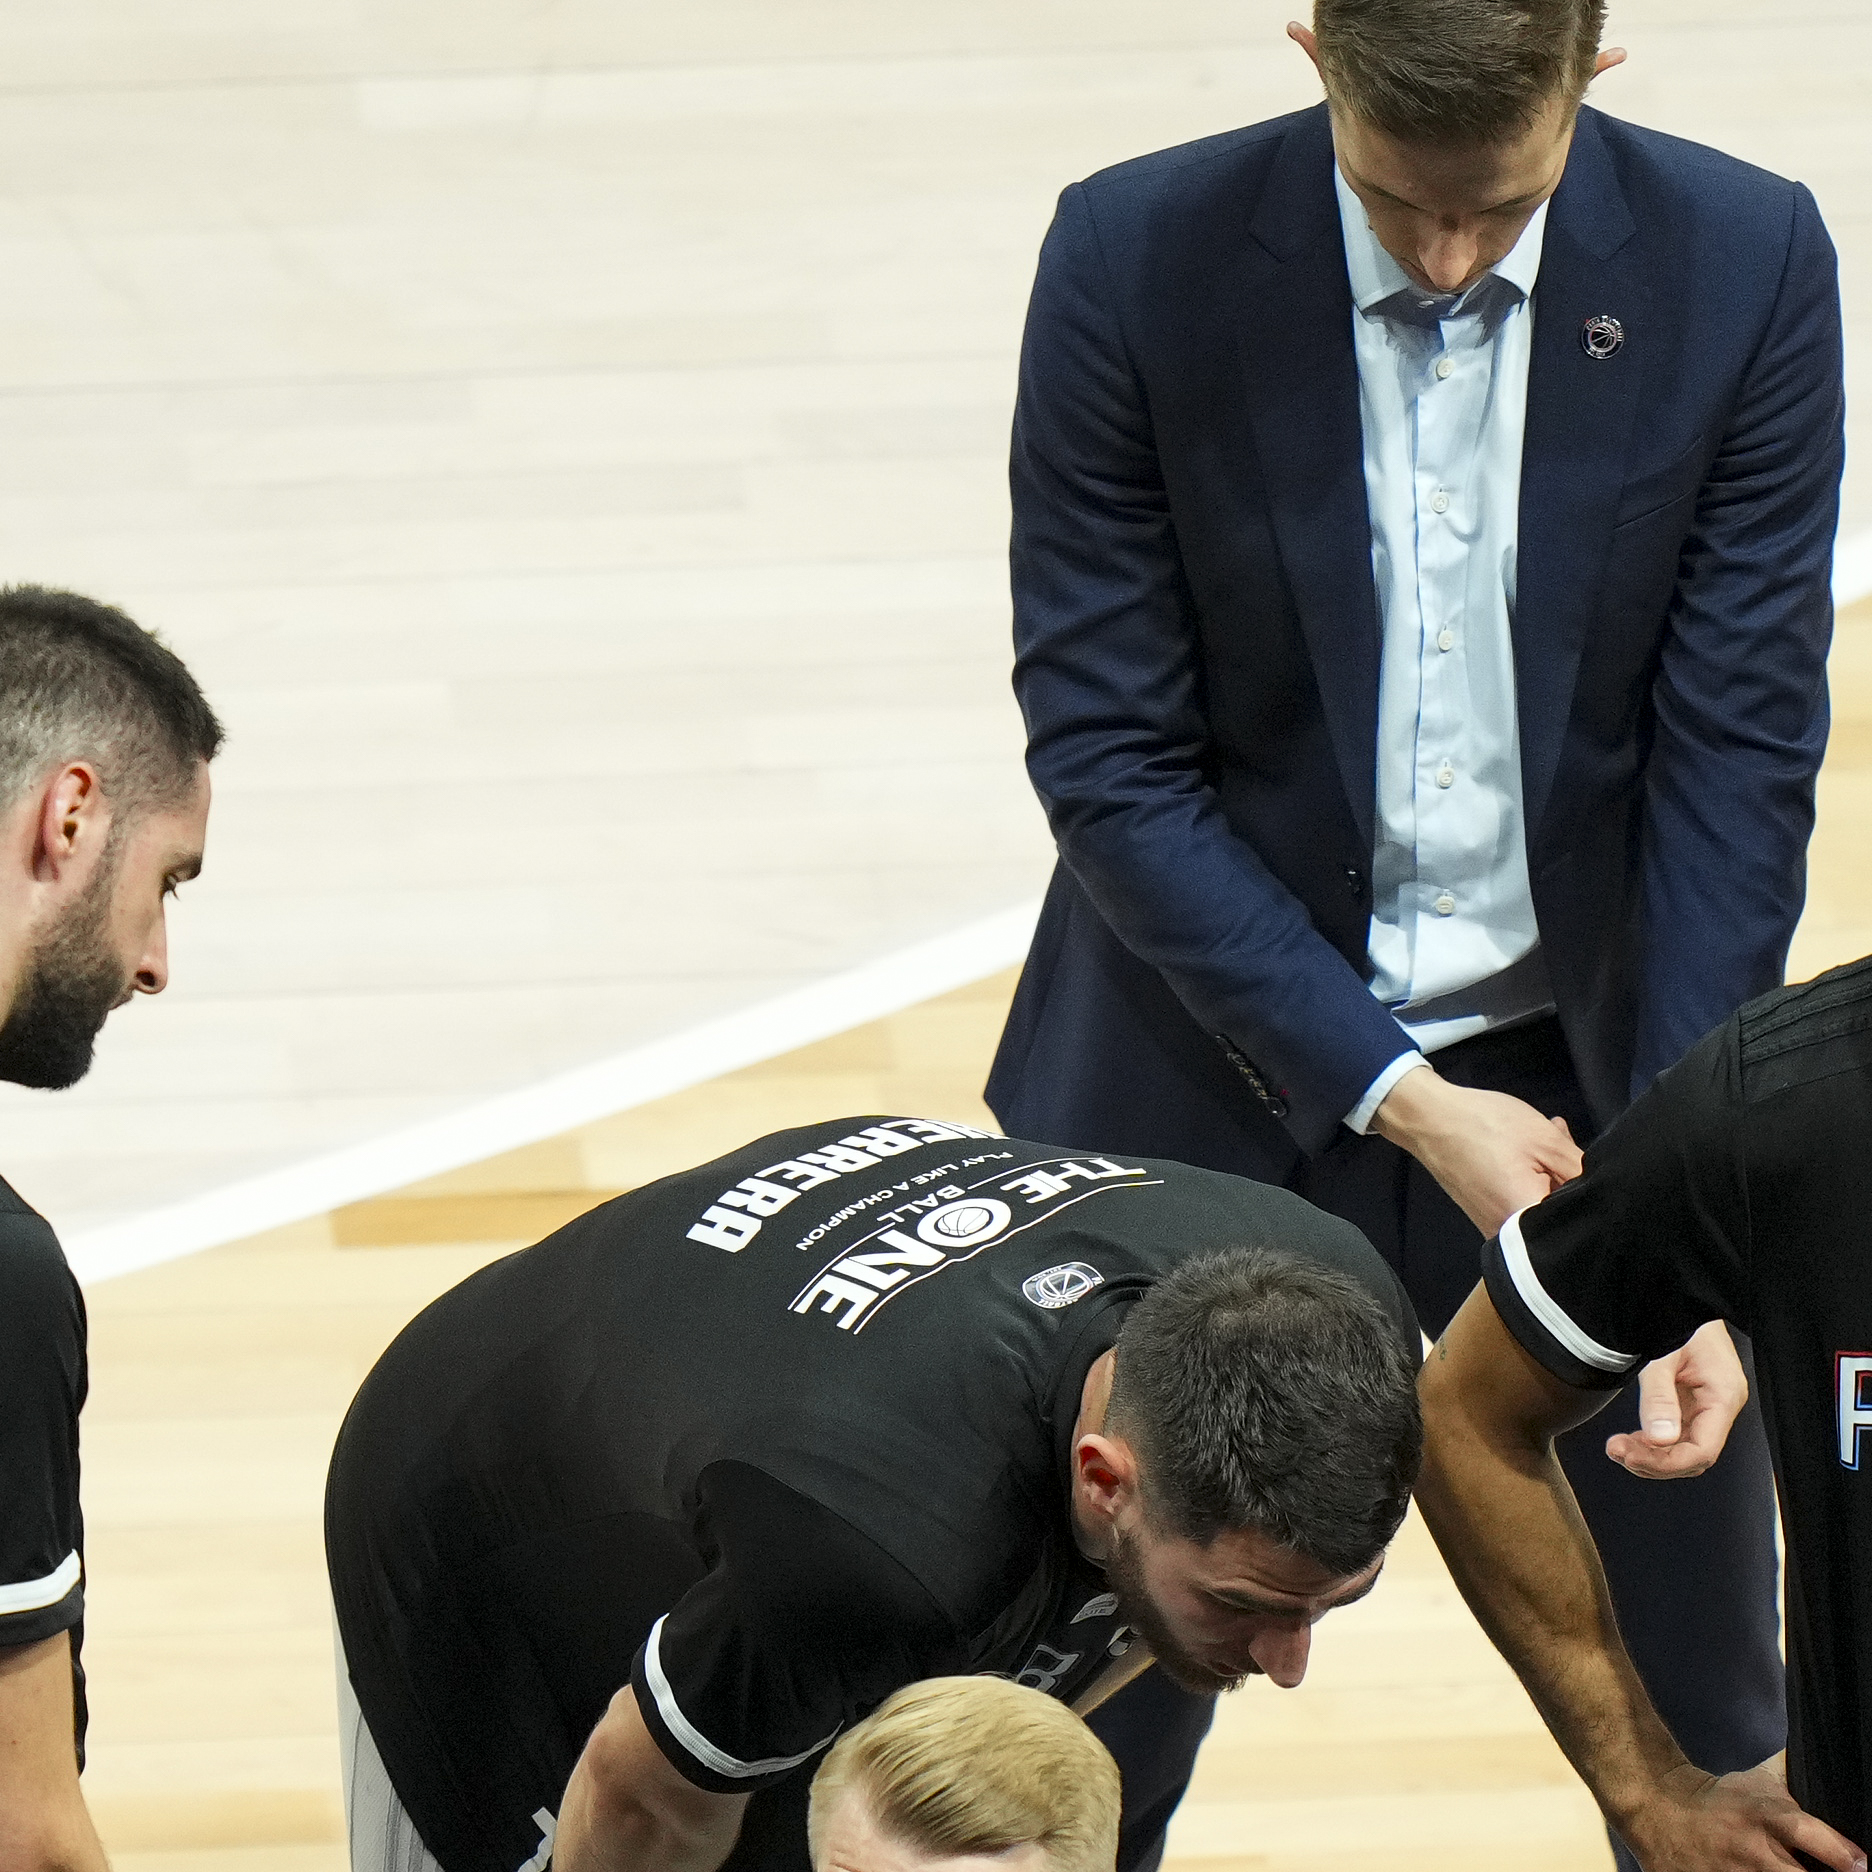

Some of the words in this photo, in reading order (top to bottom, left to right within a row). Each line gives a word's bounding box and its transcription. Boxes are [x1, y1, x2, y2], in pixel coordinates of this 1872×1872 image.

[911, 1163, 959, 1185] LIKE
[962, 1152, 1013, 1167] PLAY
[893, 1181, 909, 1191] A
[1000, 1157, 1147, 1203] THE
[796, 1190, 894, 1251] CHAMPION
[877, 1184, 966, 1223] BALL
[794, 1198, 1011, 1331] ONE
